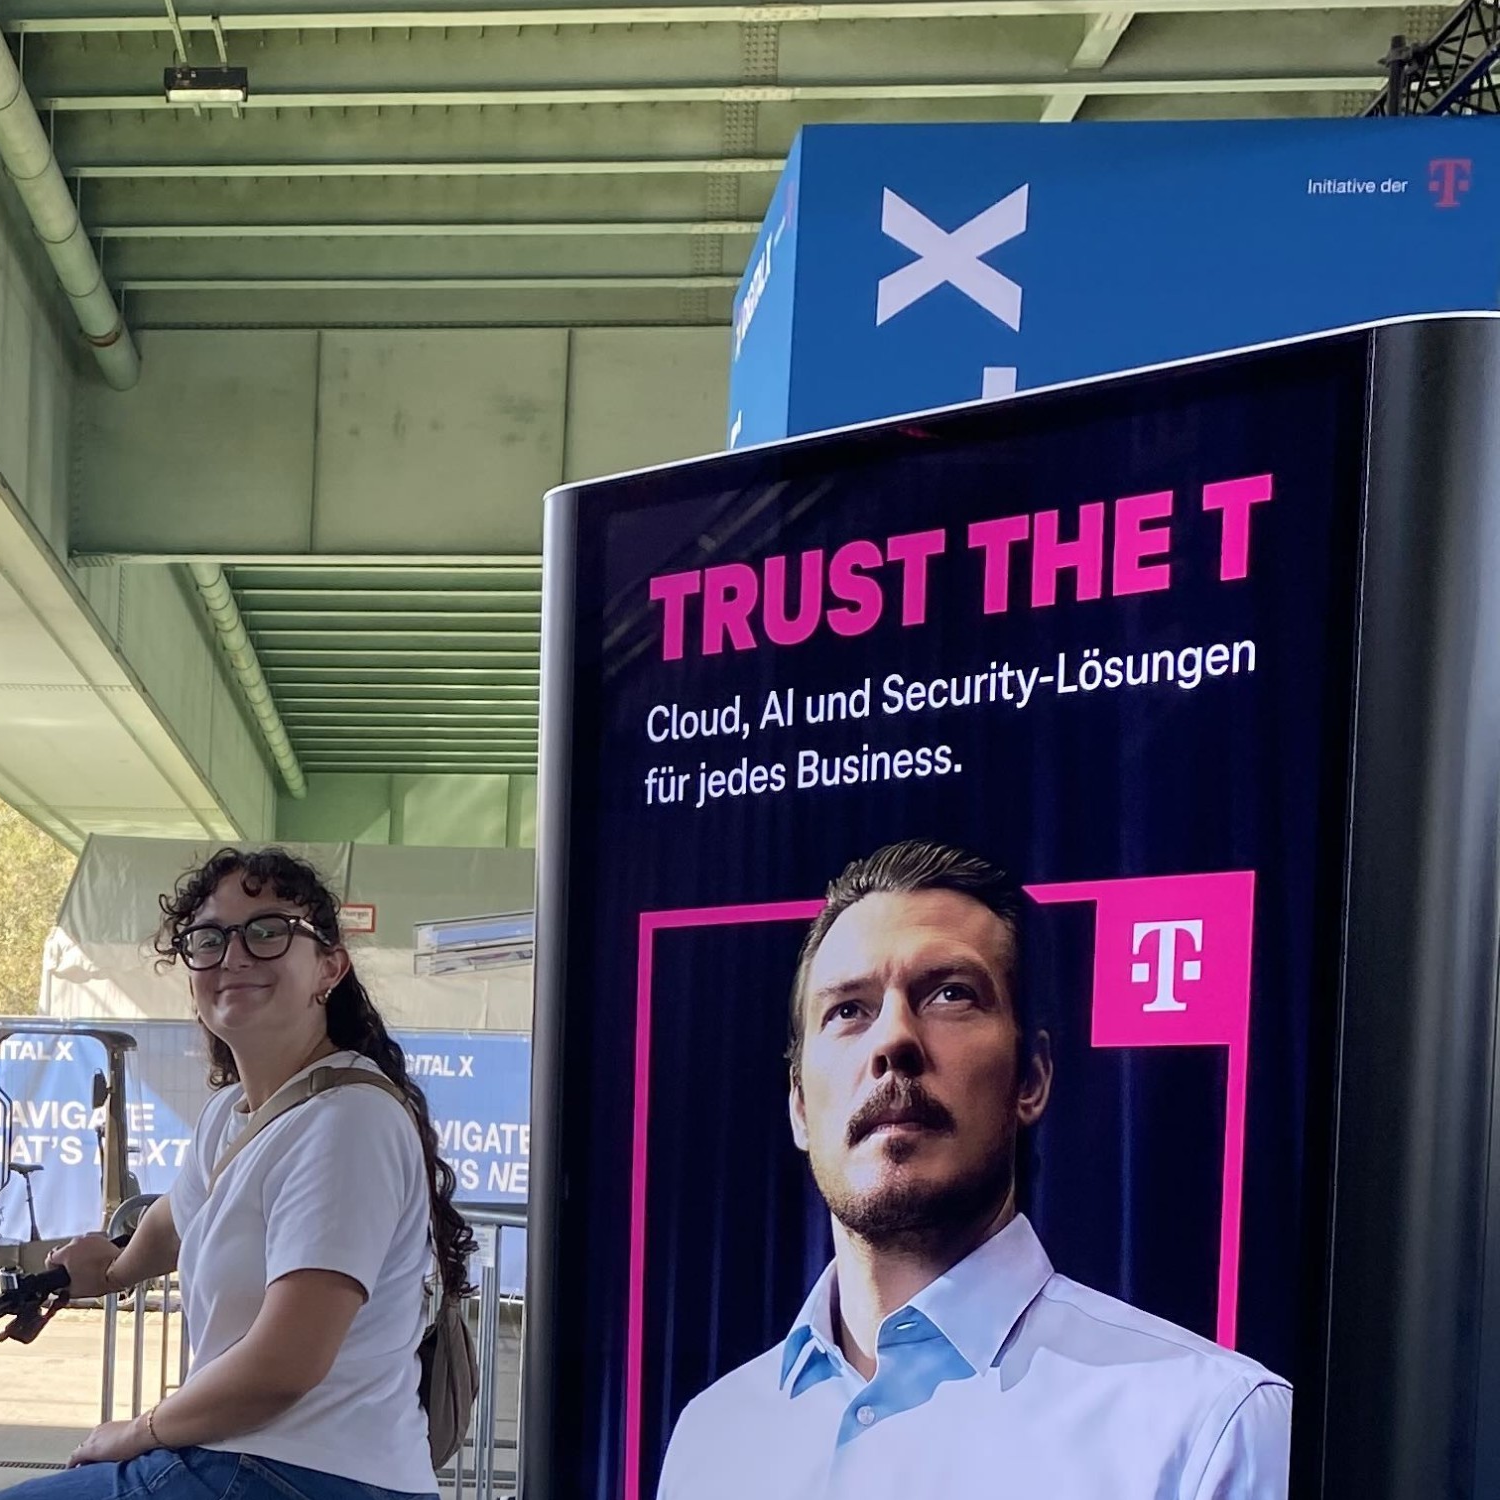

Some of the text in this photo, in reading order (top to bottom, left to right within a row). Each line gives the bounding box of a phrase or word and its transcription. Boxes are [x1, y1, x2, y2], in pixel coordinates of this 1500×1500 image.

[1307, 178, 1376, 194] Initiative
[1380, 178, 1409, 194] der
[876, 183, 1029, 332] X
[650, 473, 1273, 661] TRUST THE T
[647, 639, 1256, 742] Cloud, AI und Security-Lösungen
[645, 743, 962, 808] für jedes Business.
[55, 1040, 73, 1062] X
[405, 1054, 474, 1078] GITAL X
[434, 1119, 531, 1155] VIGATE
